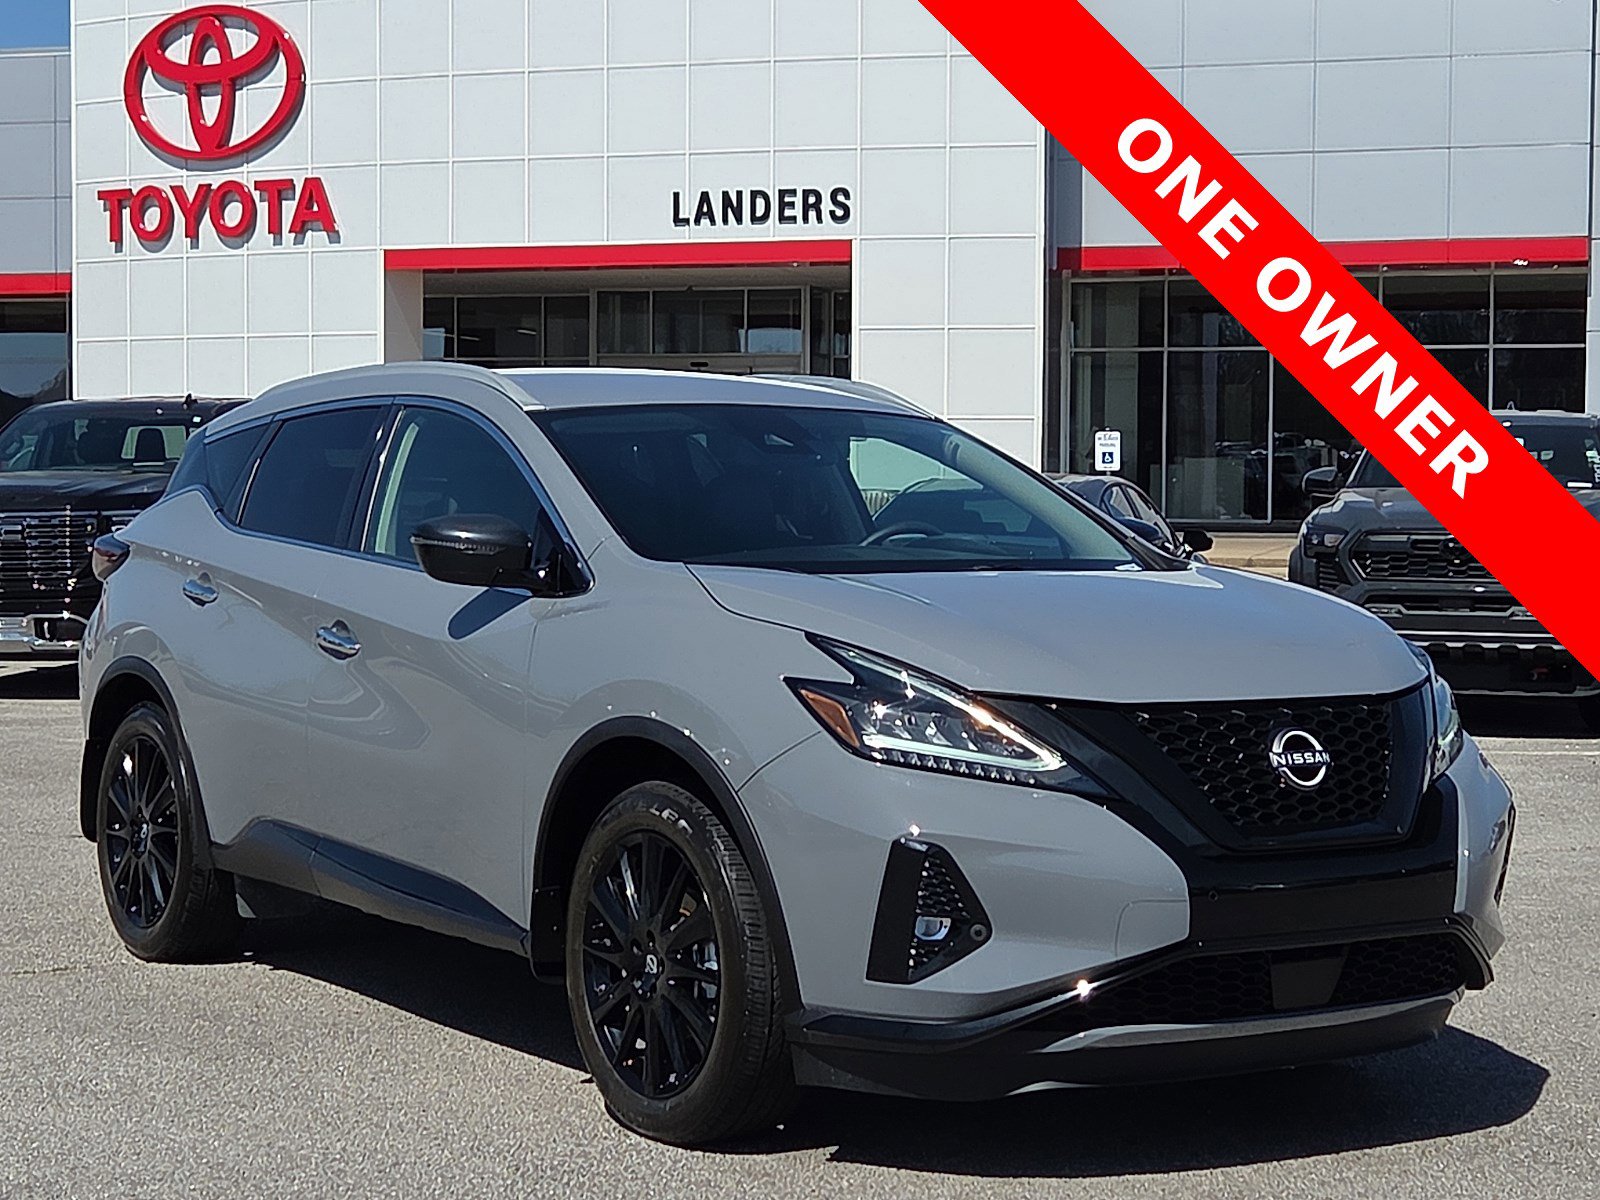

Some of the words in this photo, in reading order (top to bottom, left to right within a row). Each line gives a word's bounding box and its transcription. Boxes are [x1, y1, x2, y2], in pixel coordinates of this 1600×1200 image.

[98, 177, 338, 247] TOYOTA
[672, 187, 851, 227] LANDERS
[1269, 751, 1331, 767] NISSAN
